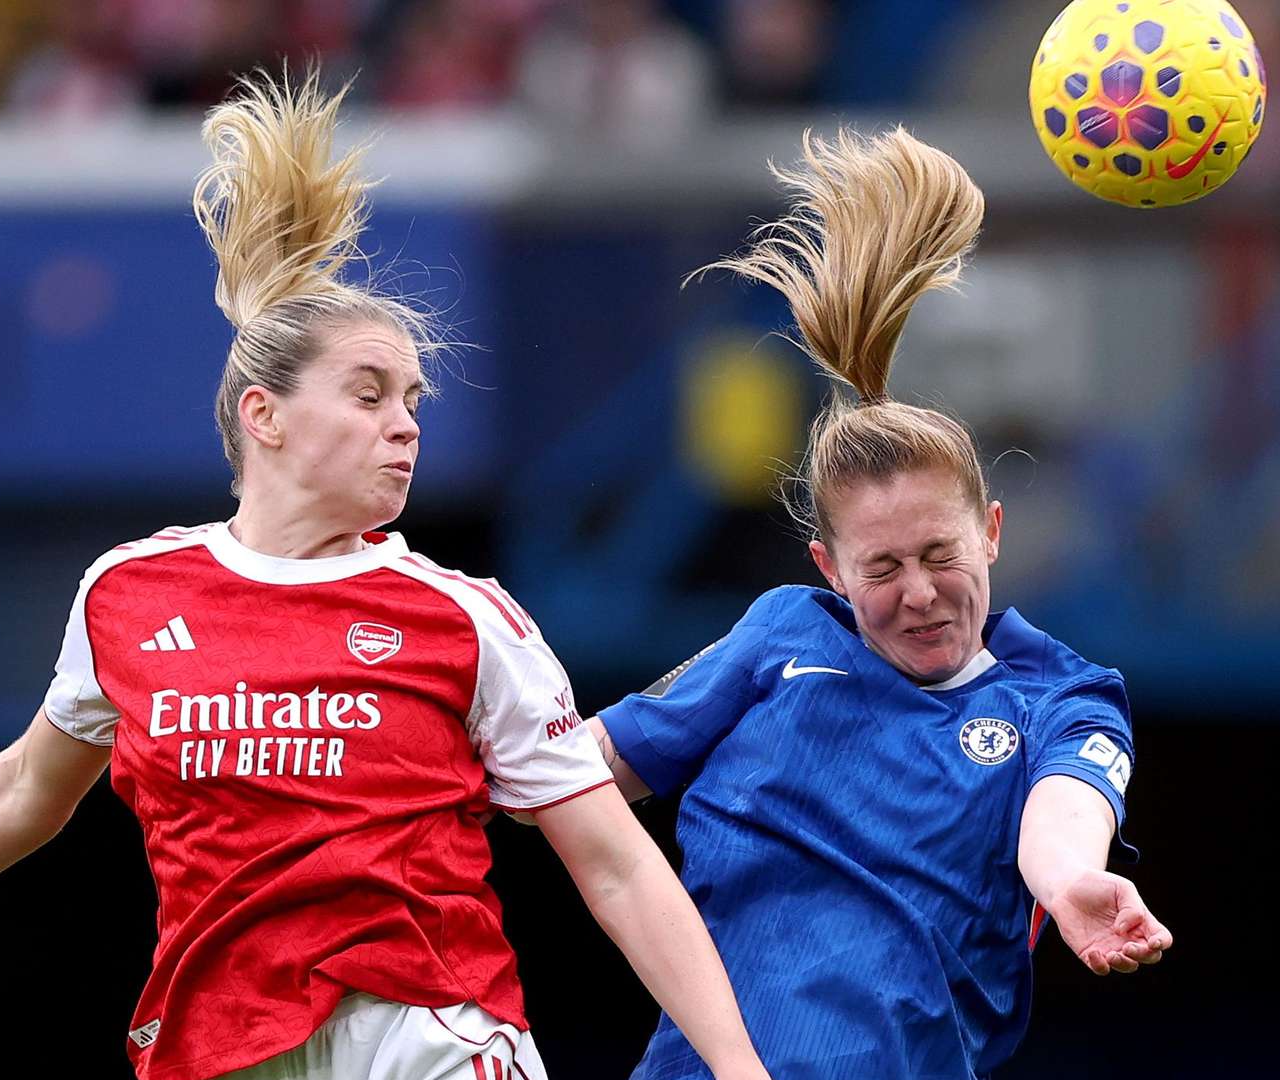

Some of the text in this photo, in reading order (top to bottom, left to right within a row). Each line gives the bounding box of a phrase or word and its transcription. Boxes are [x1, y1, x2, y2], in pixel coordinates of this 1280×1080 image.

[356, 629, 395, 642] Arsenal
[149, 681, 381, 738] Emirates
[973, 720, 1012, 732] CHELSEA
[180, 737, 346, 781] FLY BETTER
